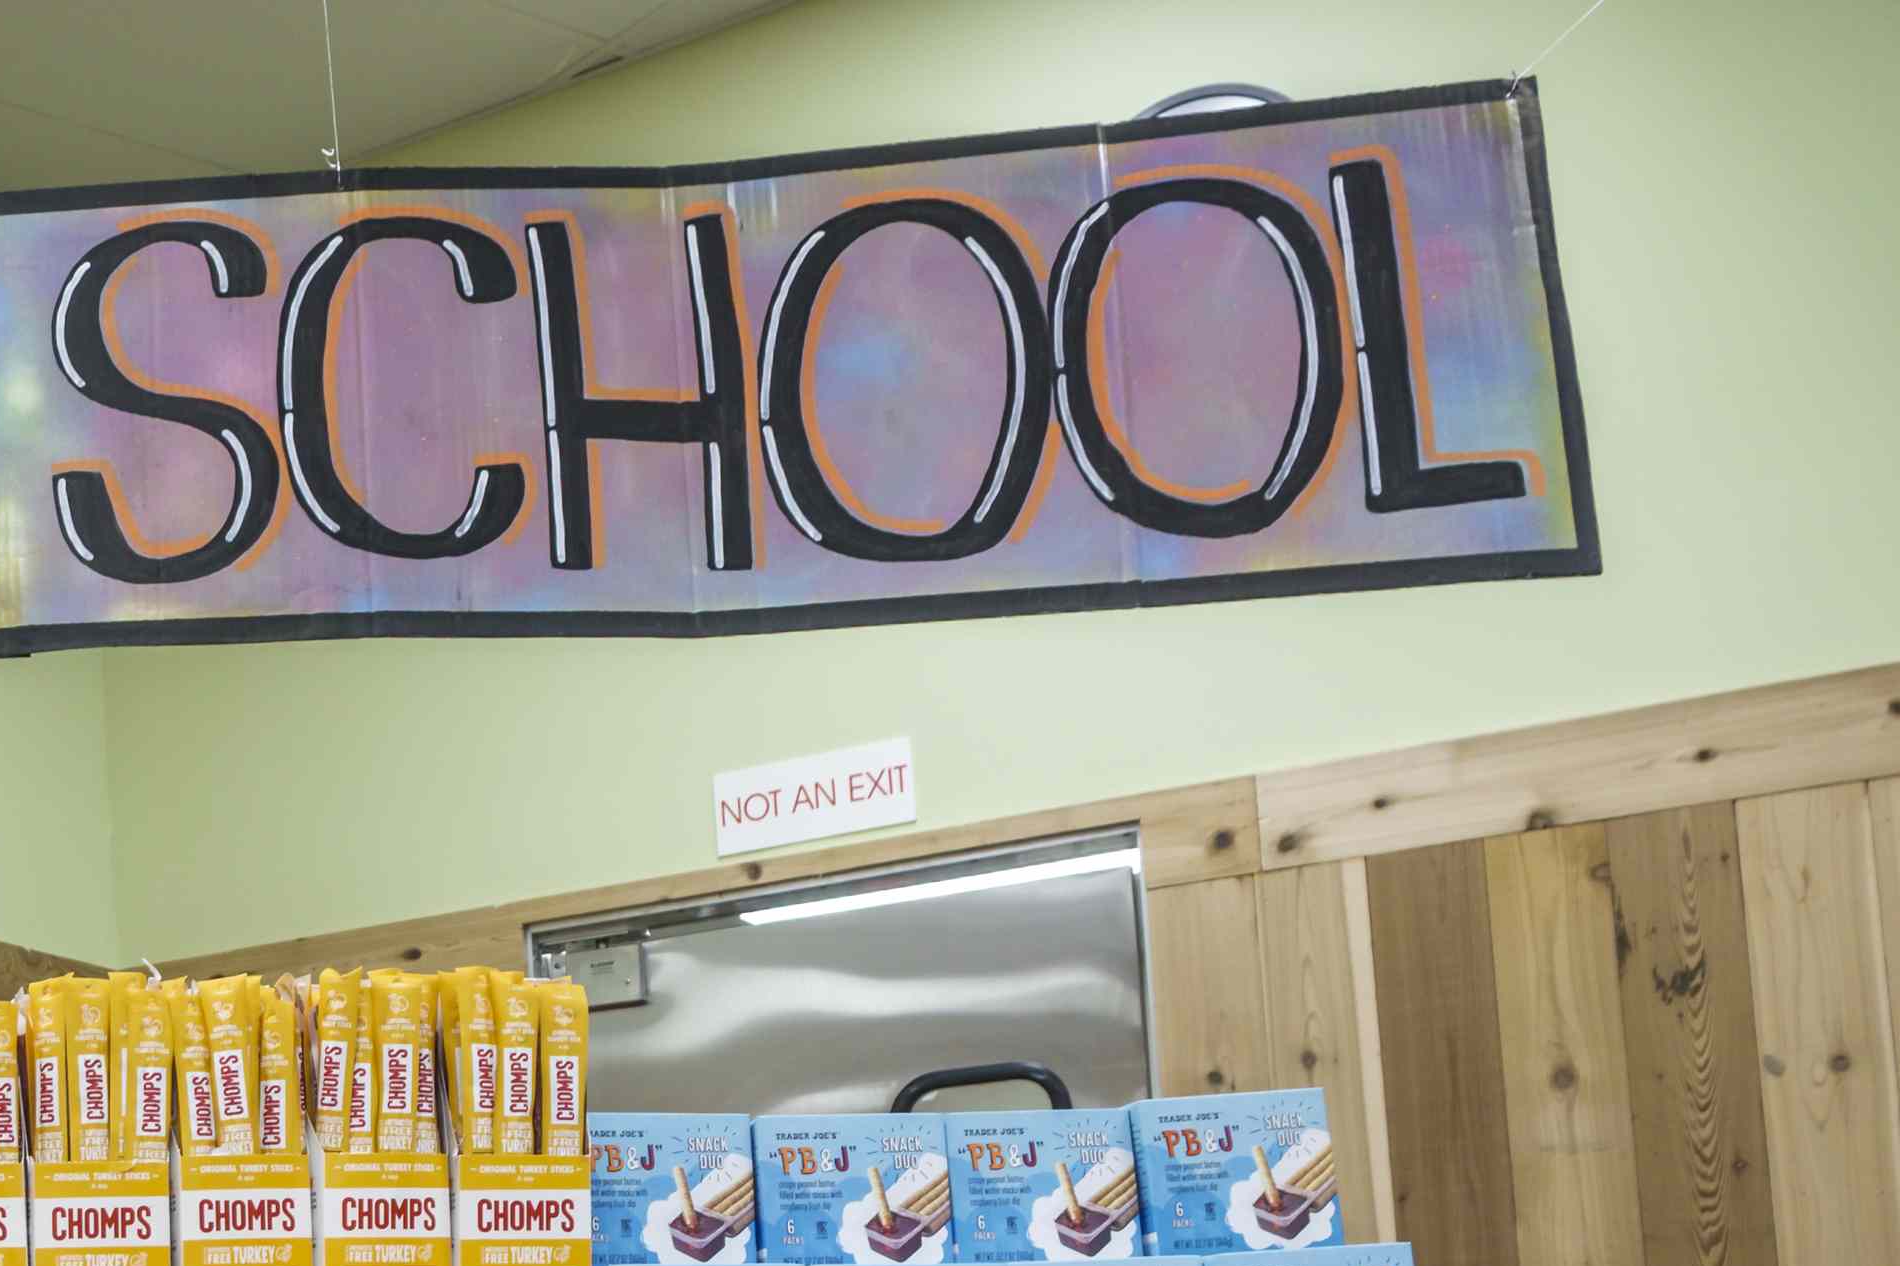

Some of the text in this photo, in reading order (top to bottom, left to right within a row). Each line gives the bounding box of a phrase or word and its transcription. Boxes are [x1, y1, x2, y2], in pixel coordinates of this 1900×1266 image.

[52, 159, 1528, 582] SCHOOL
[721, 765, 907, 827] NOT AN EXIT
[222, 1054, 248, 1117] CHOMPS
[556, 1060, 577, 1122] CHOMPS
[52, 1206, 151, 1240] CHOMPS
[199, 1199, 294, 1232] CHOMPS
[342, 1197, 435, 1230] CHOMPS
[478, 1199, 574, 1232] CHOMPS
[374, 1245, 417, 1263] TURKEY
